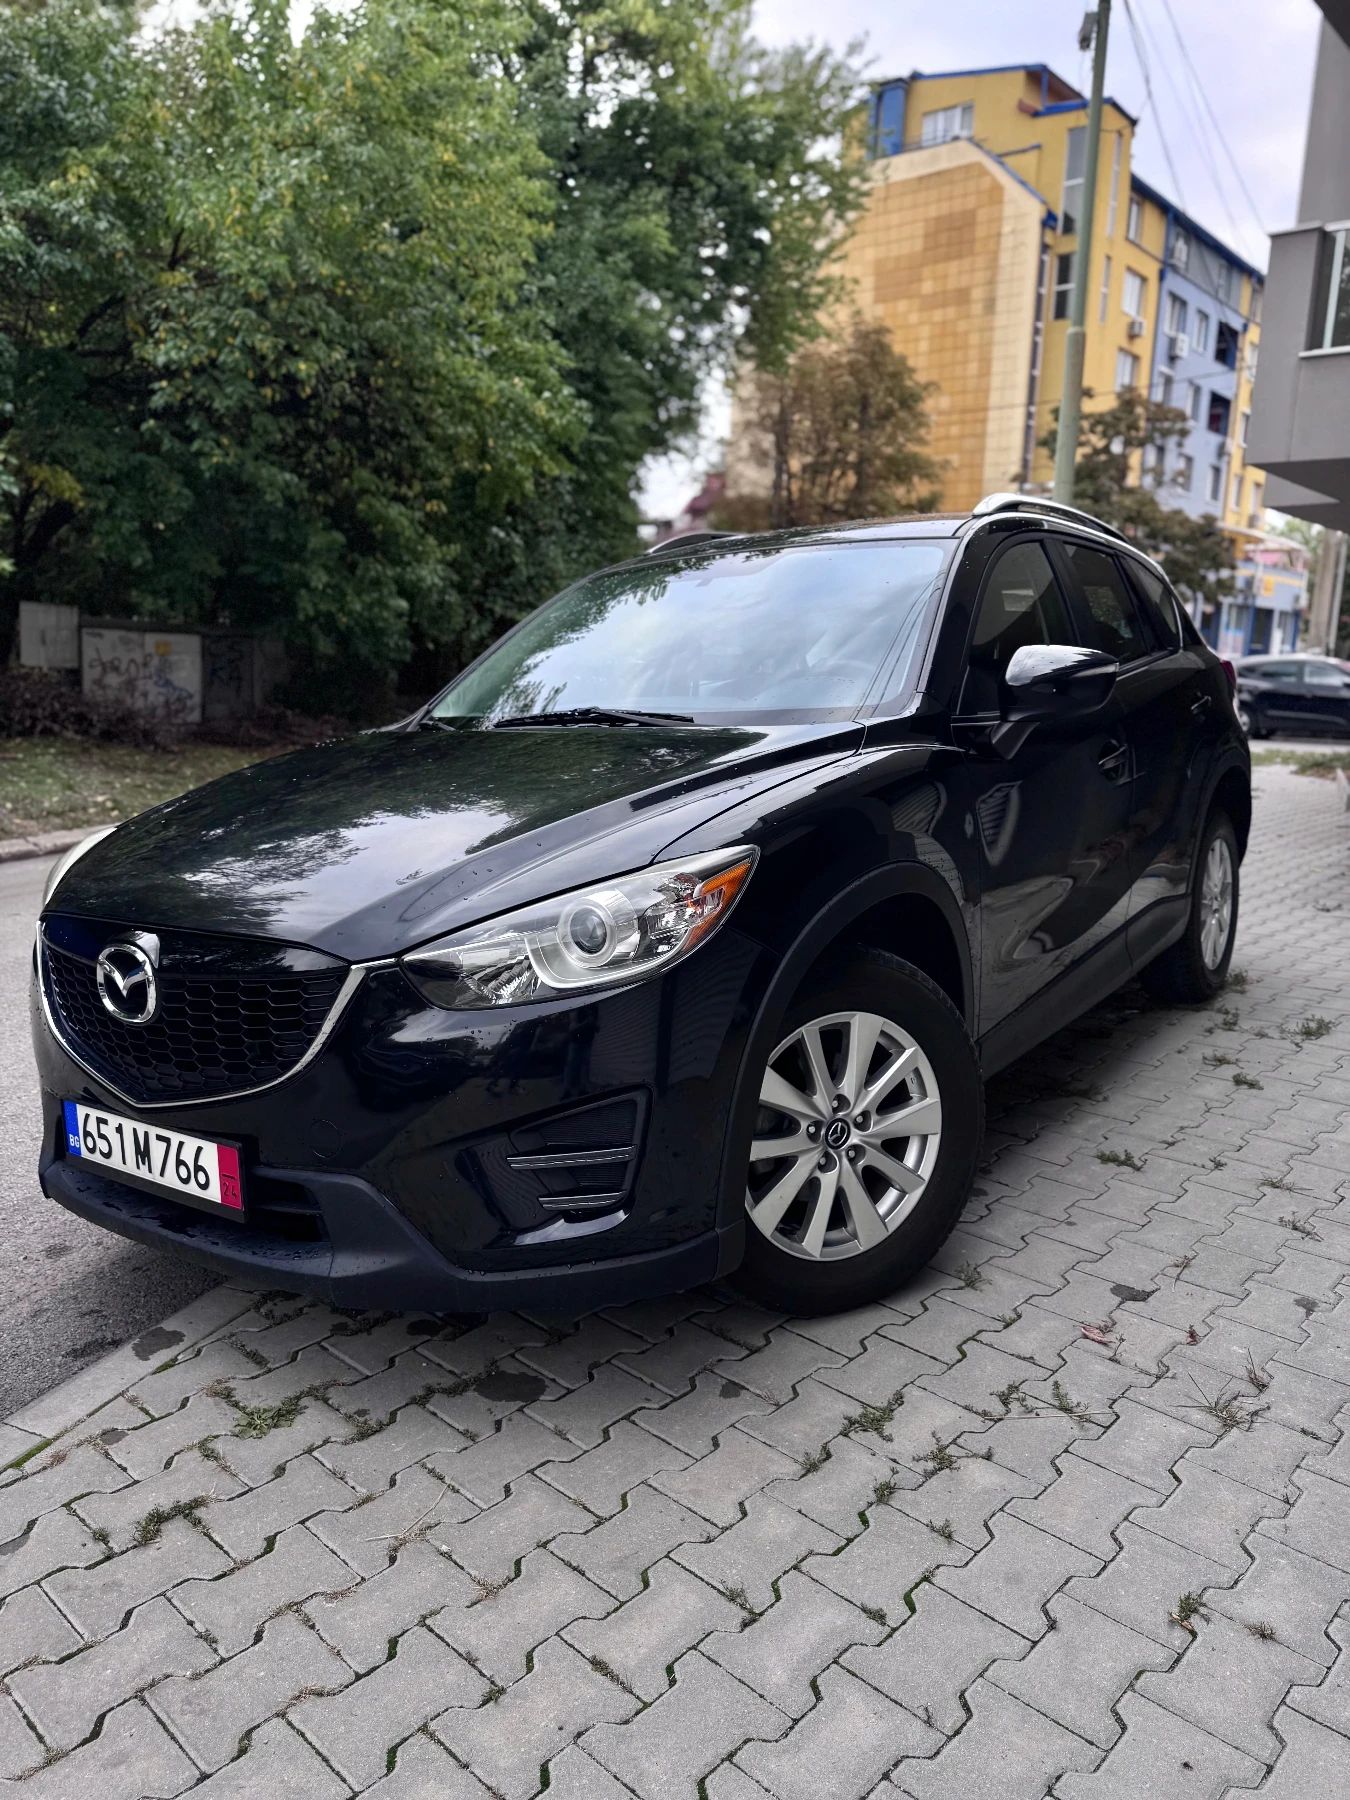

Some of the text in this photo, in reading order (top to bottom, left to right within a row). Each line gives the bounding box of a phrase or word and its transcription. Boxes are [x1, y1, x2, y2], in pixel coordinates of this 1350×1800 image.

[69, 1133, 80, 1148] BG
[82, 1112, 210, 1191] 651M766
[222, 1181, 238, 1199] 24
